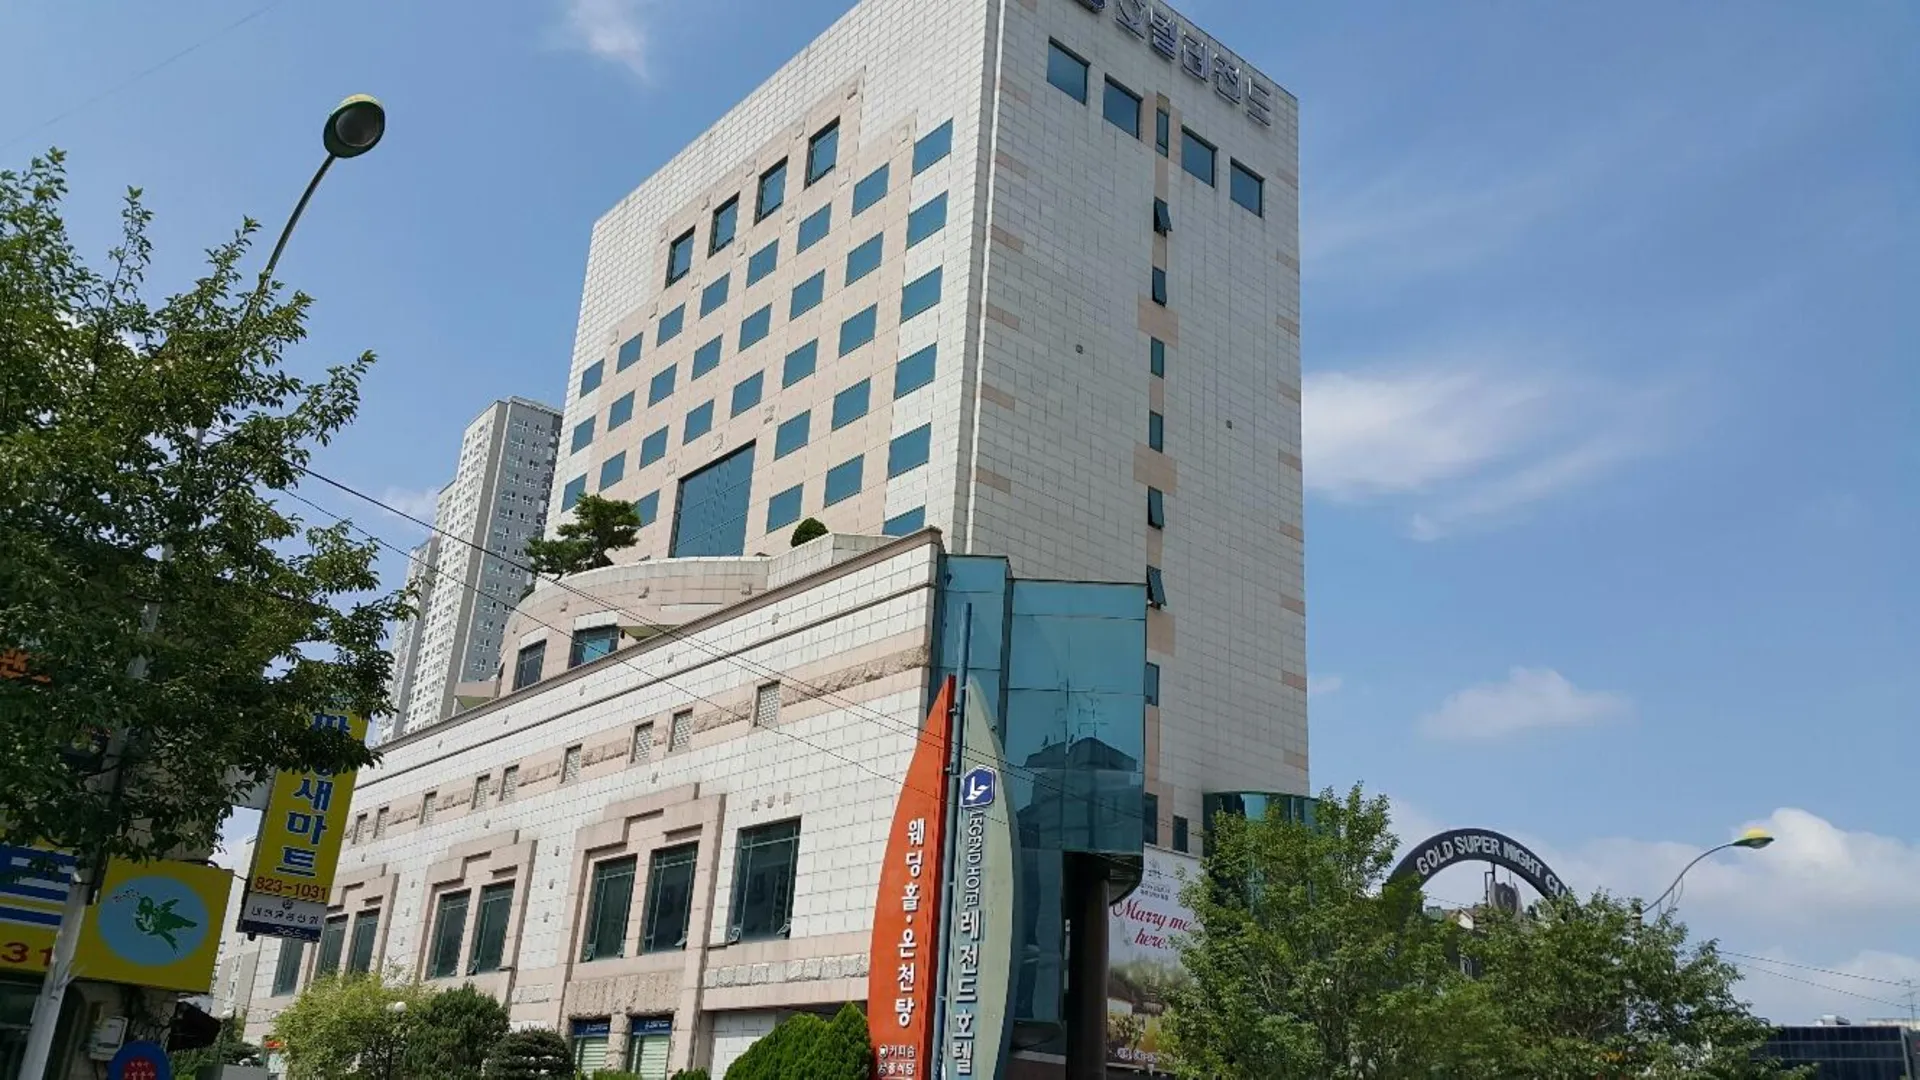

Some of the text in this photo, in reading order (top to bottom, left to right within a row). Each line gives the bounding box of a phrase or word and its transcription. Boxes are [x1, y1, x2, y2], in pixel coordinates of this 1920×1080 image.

[965, 811, 984, 908] LEGEND HOTEL
[1416, 841, 1454, 876] GOLD
[1454, 835, 1501, 857] SUPER
[1503, 841, 1543, 878] NIGHT
[254, 876, 327, 900] 823-1031
[1112, 899, 1167, 931] Marry
